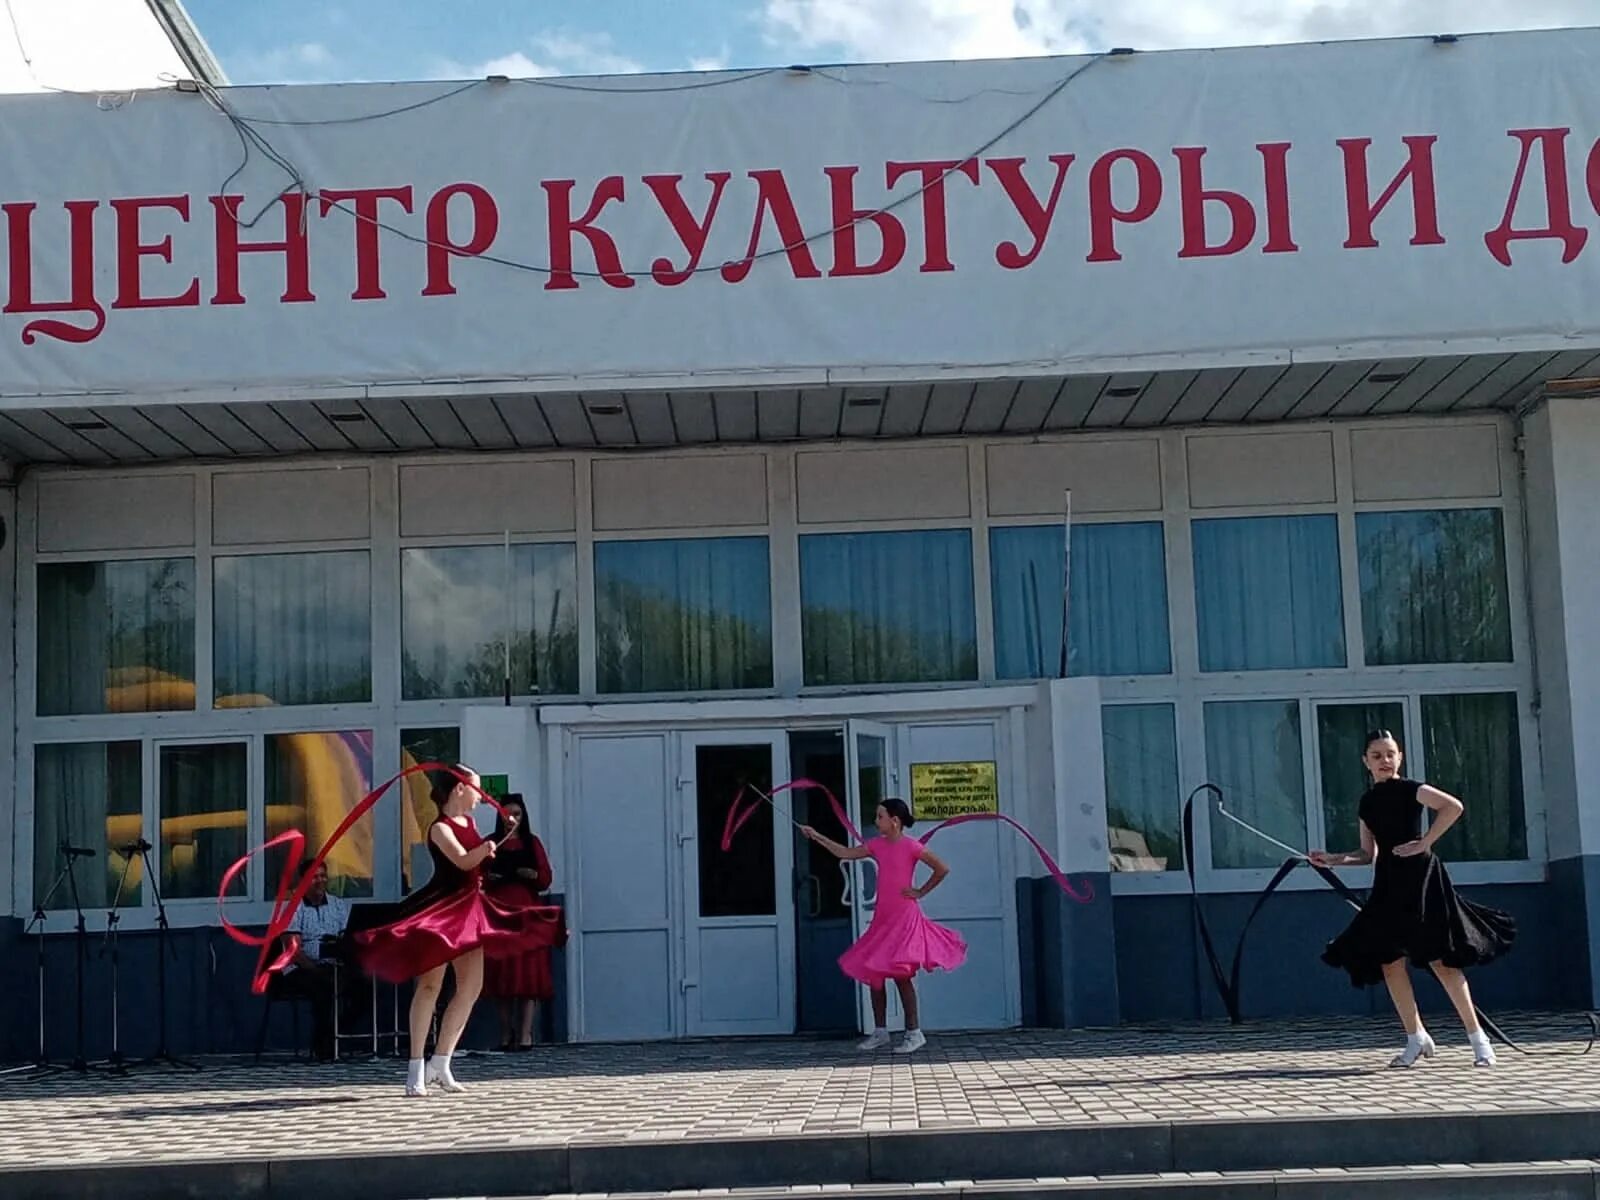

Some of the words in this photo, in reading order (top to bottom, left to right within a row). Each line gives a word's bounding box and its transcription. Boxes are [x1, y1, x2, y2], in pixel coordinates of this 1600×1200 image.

[3, 183, 499, 343] ЦЕНТР
[541, 144, 1298, 290] КУЛЬТУРЫ
[1336, 135, 1446, 249] И
[1484, 128, 1600, 267] Д
